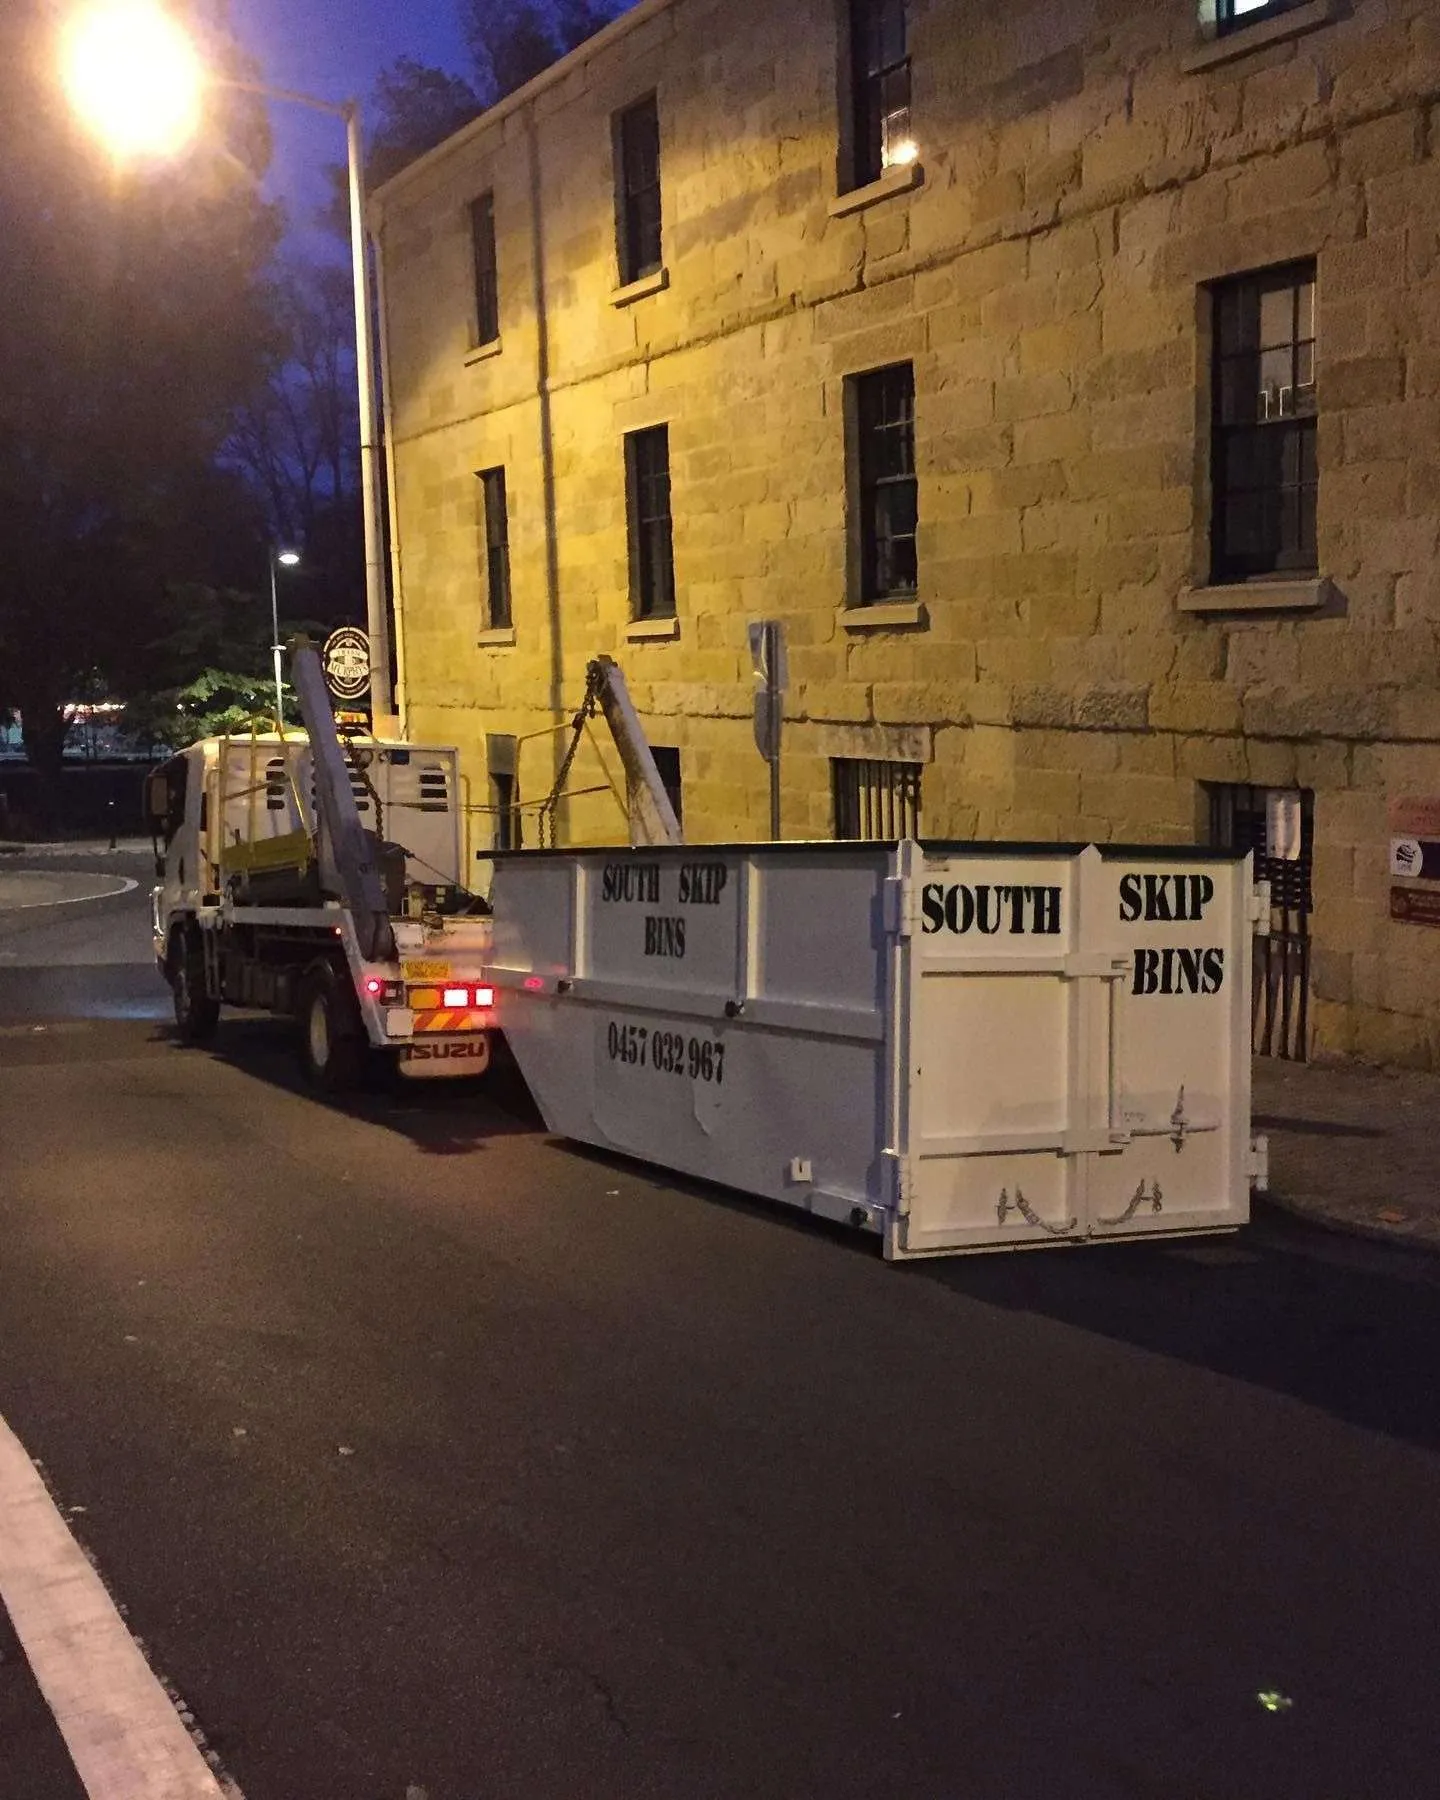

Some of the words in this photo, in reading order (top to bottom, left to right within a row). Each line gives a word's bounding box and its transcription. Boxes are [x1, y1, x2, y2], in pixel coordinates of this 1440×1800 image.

[602, 863, 660, 903] SOUTH
[678, 862, 728, 904] SKIP
[921, 883, 1062, 934] SOUTH
[1119, 873, 1214, 922] SKIP
[644, 916, 686, 958] BINS
[1131, 948, 1225, 995] BINS
[407, 1043, 485, 1060] ISUZU
[607, 1021, 647, 1067] 0457
[652, 1030, 684, 1075] 032
[689, 1037, 725, 1085] 967
